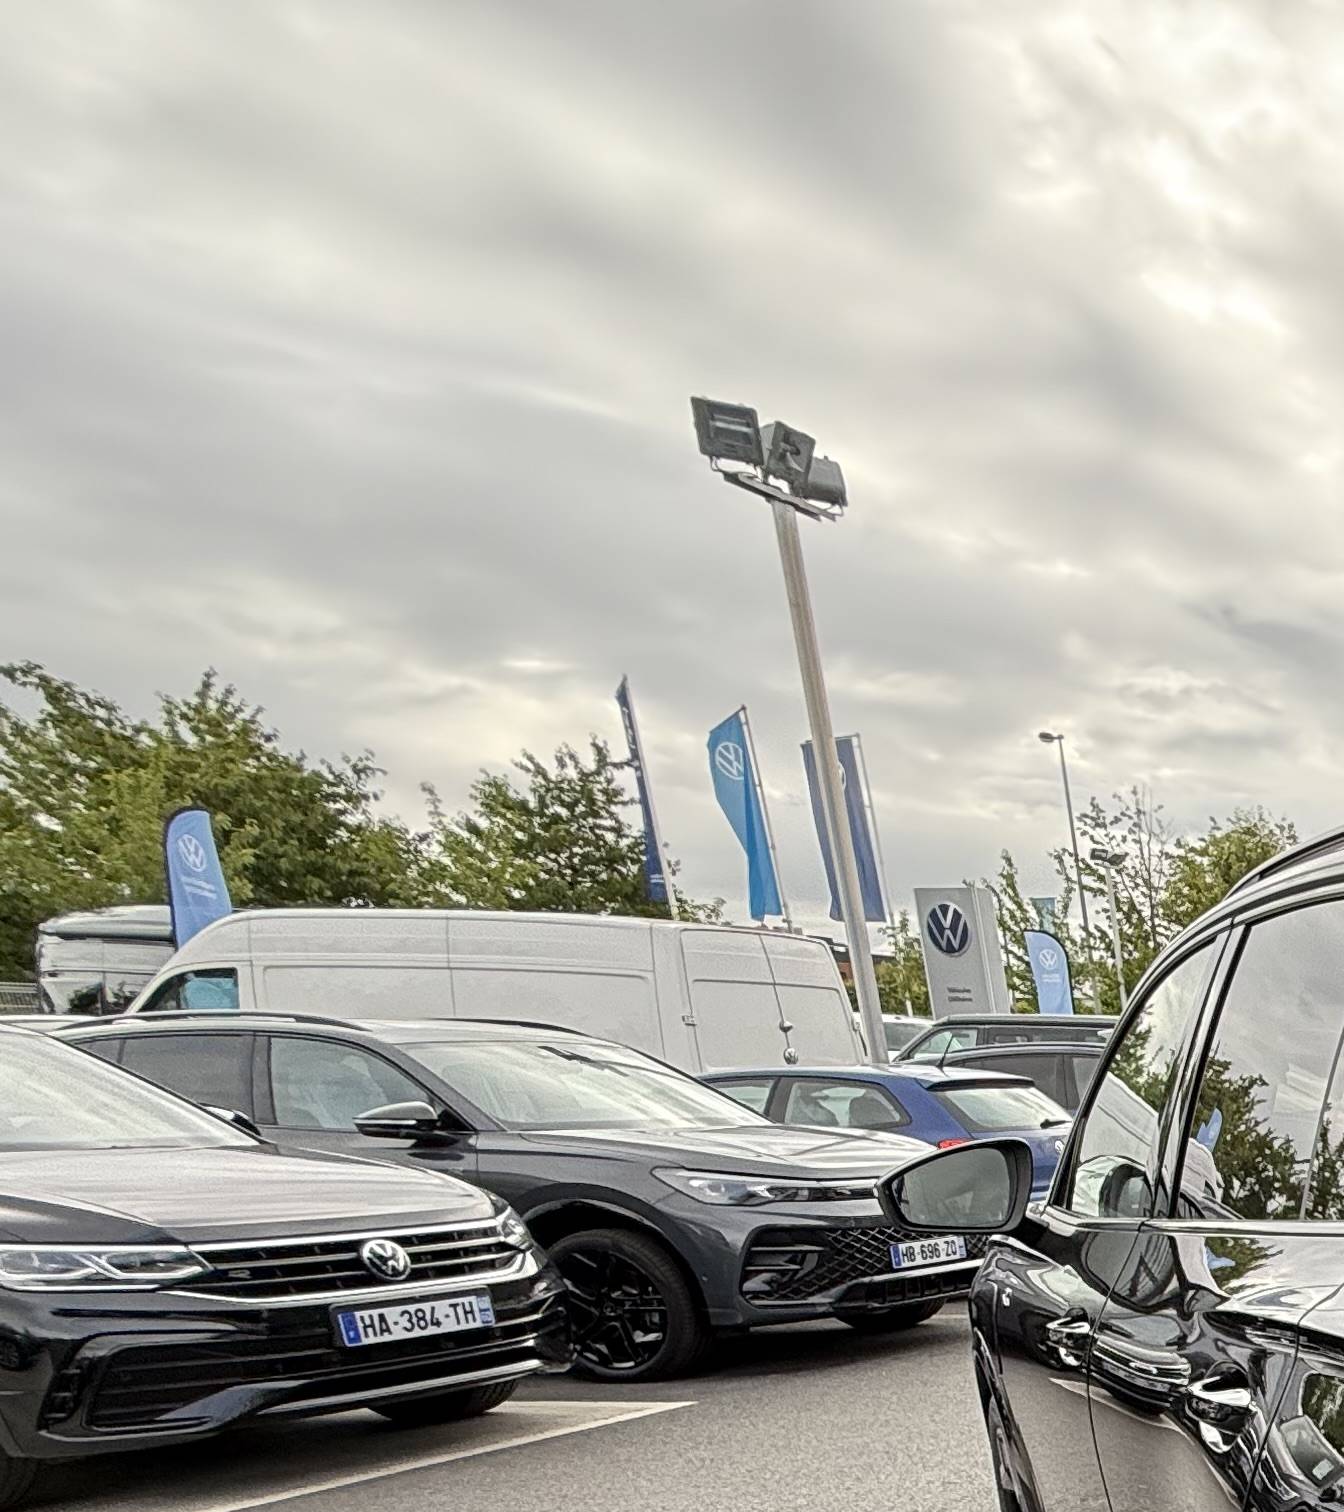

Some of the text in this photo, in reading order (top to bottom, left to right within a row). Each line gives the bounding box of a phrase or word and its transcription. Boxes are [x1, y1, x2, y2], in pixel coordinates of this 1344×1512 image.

[927, 903, 969, 954] VW
[361, 1239, 411, 1281] VW
[359, 1301, 477, 1339] HA-384-TH
